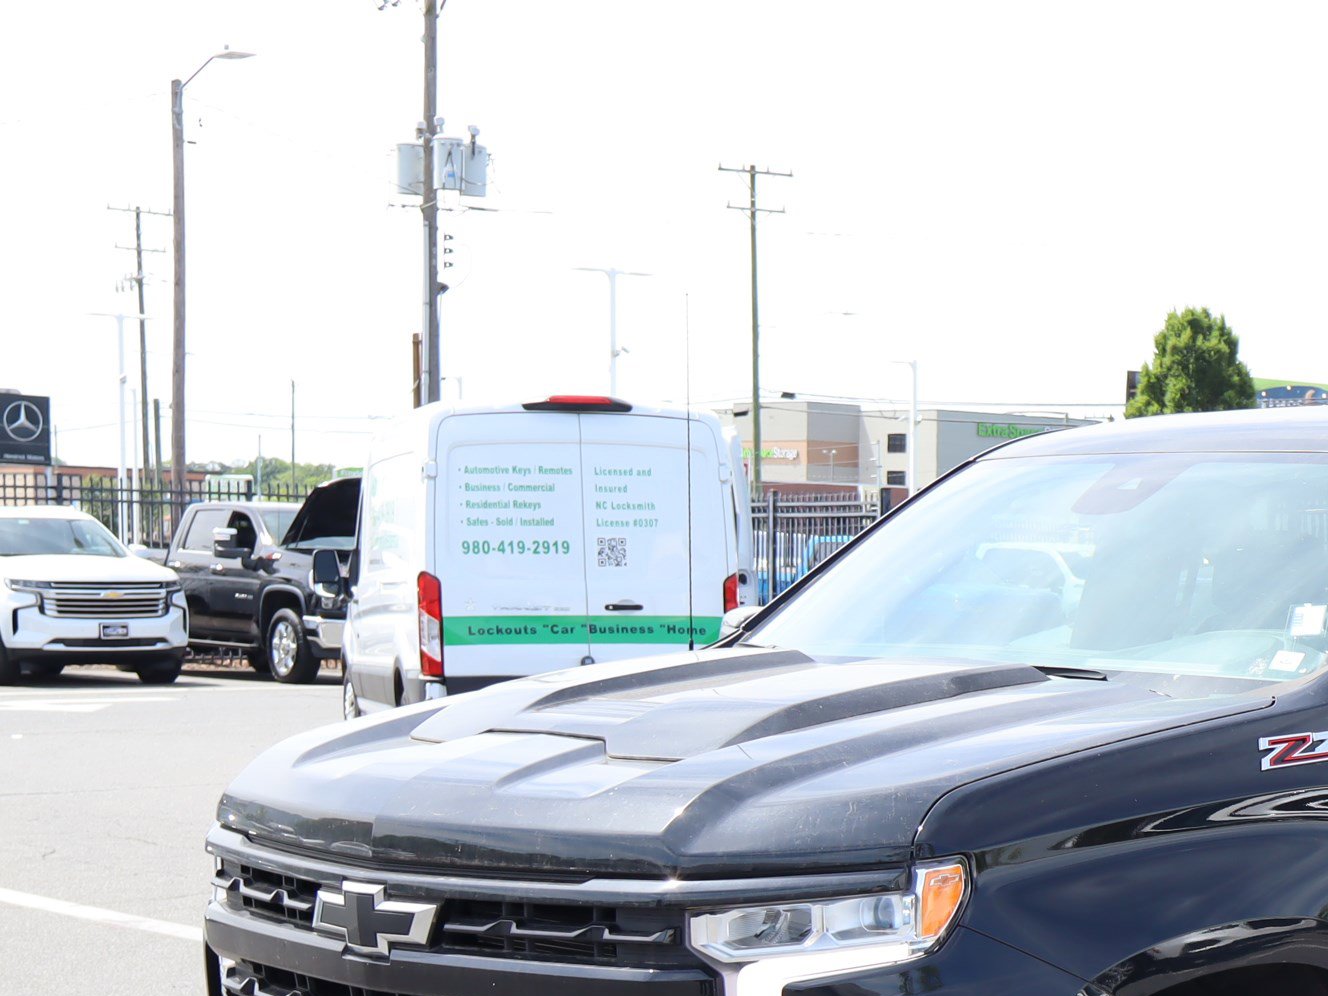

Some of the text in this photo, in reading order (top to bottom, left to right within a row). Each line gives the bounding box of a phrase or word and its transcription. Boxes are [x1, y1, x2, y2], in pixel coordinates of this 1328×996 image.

[464, 465, 510, 475] Automotive
[511, 465, 532, 477] Keys
[538, 465, 573, 475] Remotes
[594, 466, 652, 477] Licensed and
[464, 482, 501, 492] Business
[507, 482, 555, 492] Commercial
[595, 483, 628, 493] Insured
[465, 499, 542, 511] Residential Rekeys
[595, 500, 656, 511] NC Locksmith
[495, 517, 514, 527] Sold
[520, 517, 555, 527] Installed
[596, 518, 630, 528] License
[461, 540, 570, 555] 980-419-2919
[468, 625, 537, 636] Lockouts
